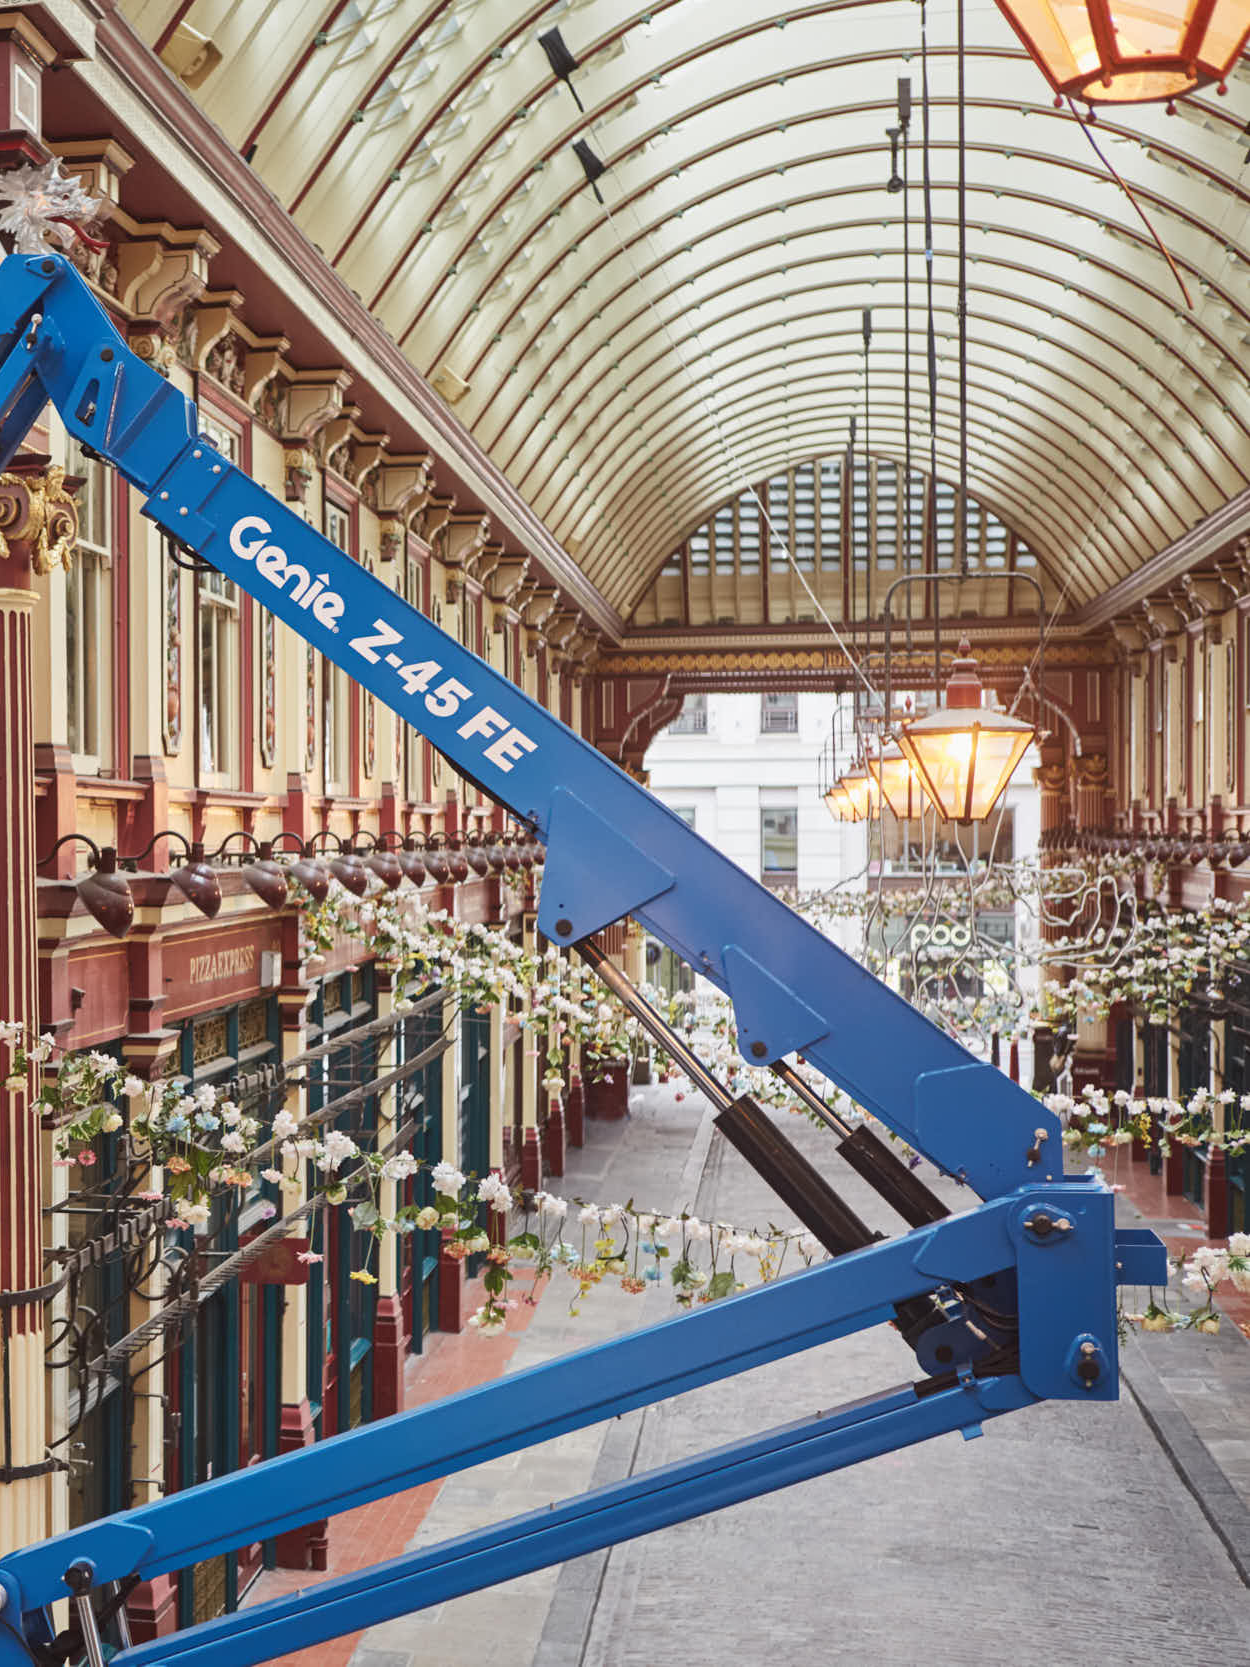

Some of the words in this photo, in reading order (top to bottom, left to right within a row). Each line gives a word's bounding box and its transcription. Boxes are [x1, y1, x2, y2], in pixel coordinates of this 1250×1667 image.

[348, 618, 474, 718] Z-45
[456, 705, 539, 774] FE
[911, 917, 971, 953] pod
[190, 945, 254, 984] PIZZAEXPRESS
